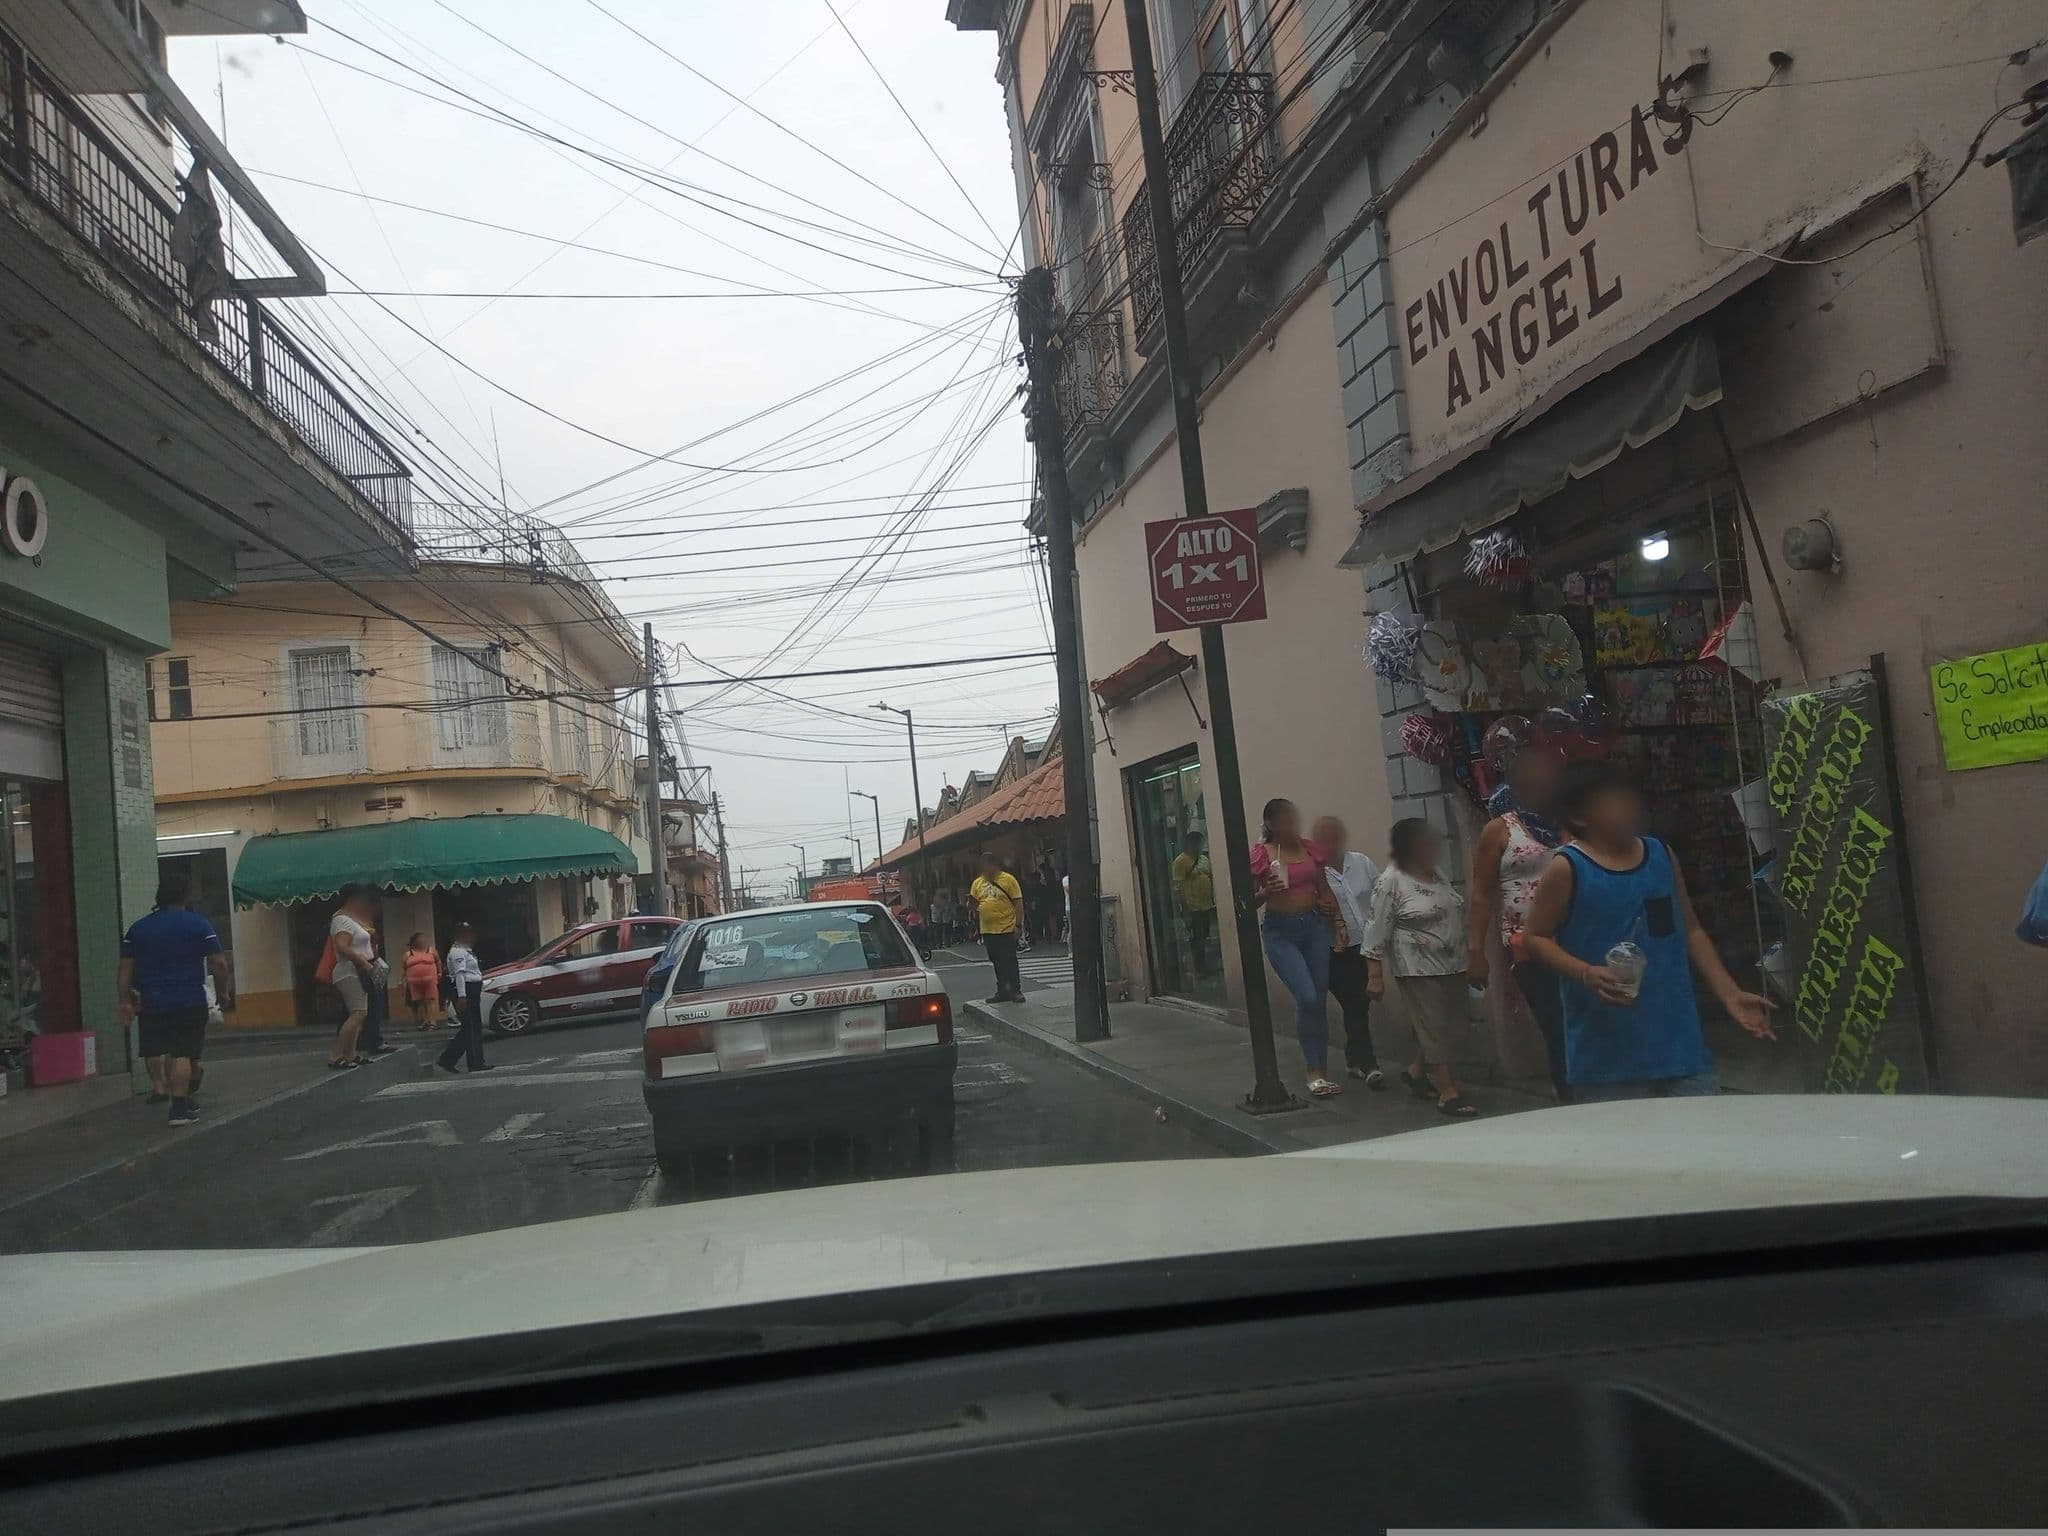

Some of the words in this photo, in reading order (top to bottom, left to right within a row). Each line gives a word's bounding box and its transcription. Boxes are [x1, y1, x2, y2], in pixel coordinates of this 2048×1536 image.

[1406, 76, 1693, 367] ENVOLTURAS
[1445, 239, 1623, 417] ANGEL
[0, 468, 48, 558] O
[1177, 527, 1233, 558] ALTO
[1186, 594, 1219, 604] PRIMERO
[1186, 603, 1220, 613] DESPUES
[1938, 666, 1971, 704] Se
[1971, 648, 2048, 695] Solicit
[1769, 694, 1822, 808] COPIA
[706, 926, 743, 947] 1016
[675, 1010, 711, 1022] TSURU
[726, 996, 779, 1017] RADIO
[814, 988, 849, 1007] TAXI
